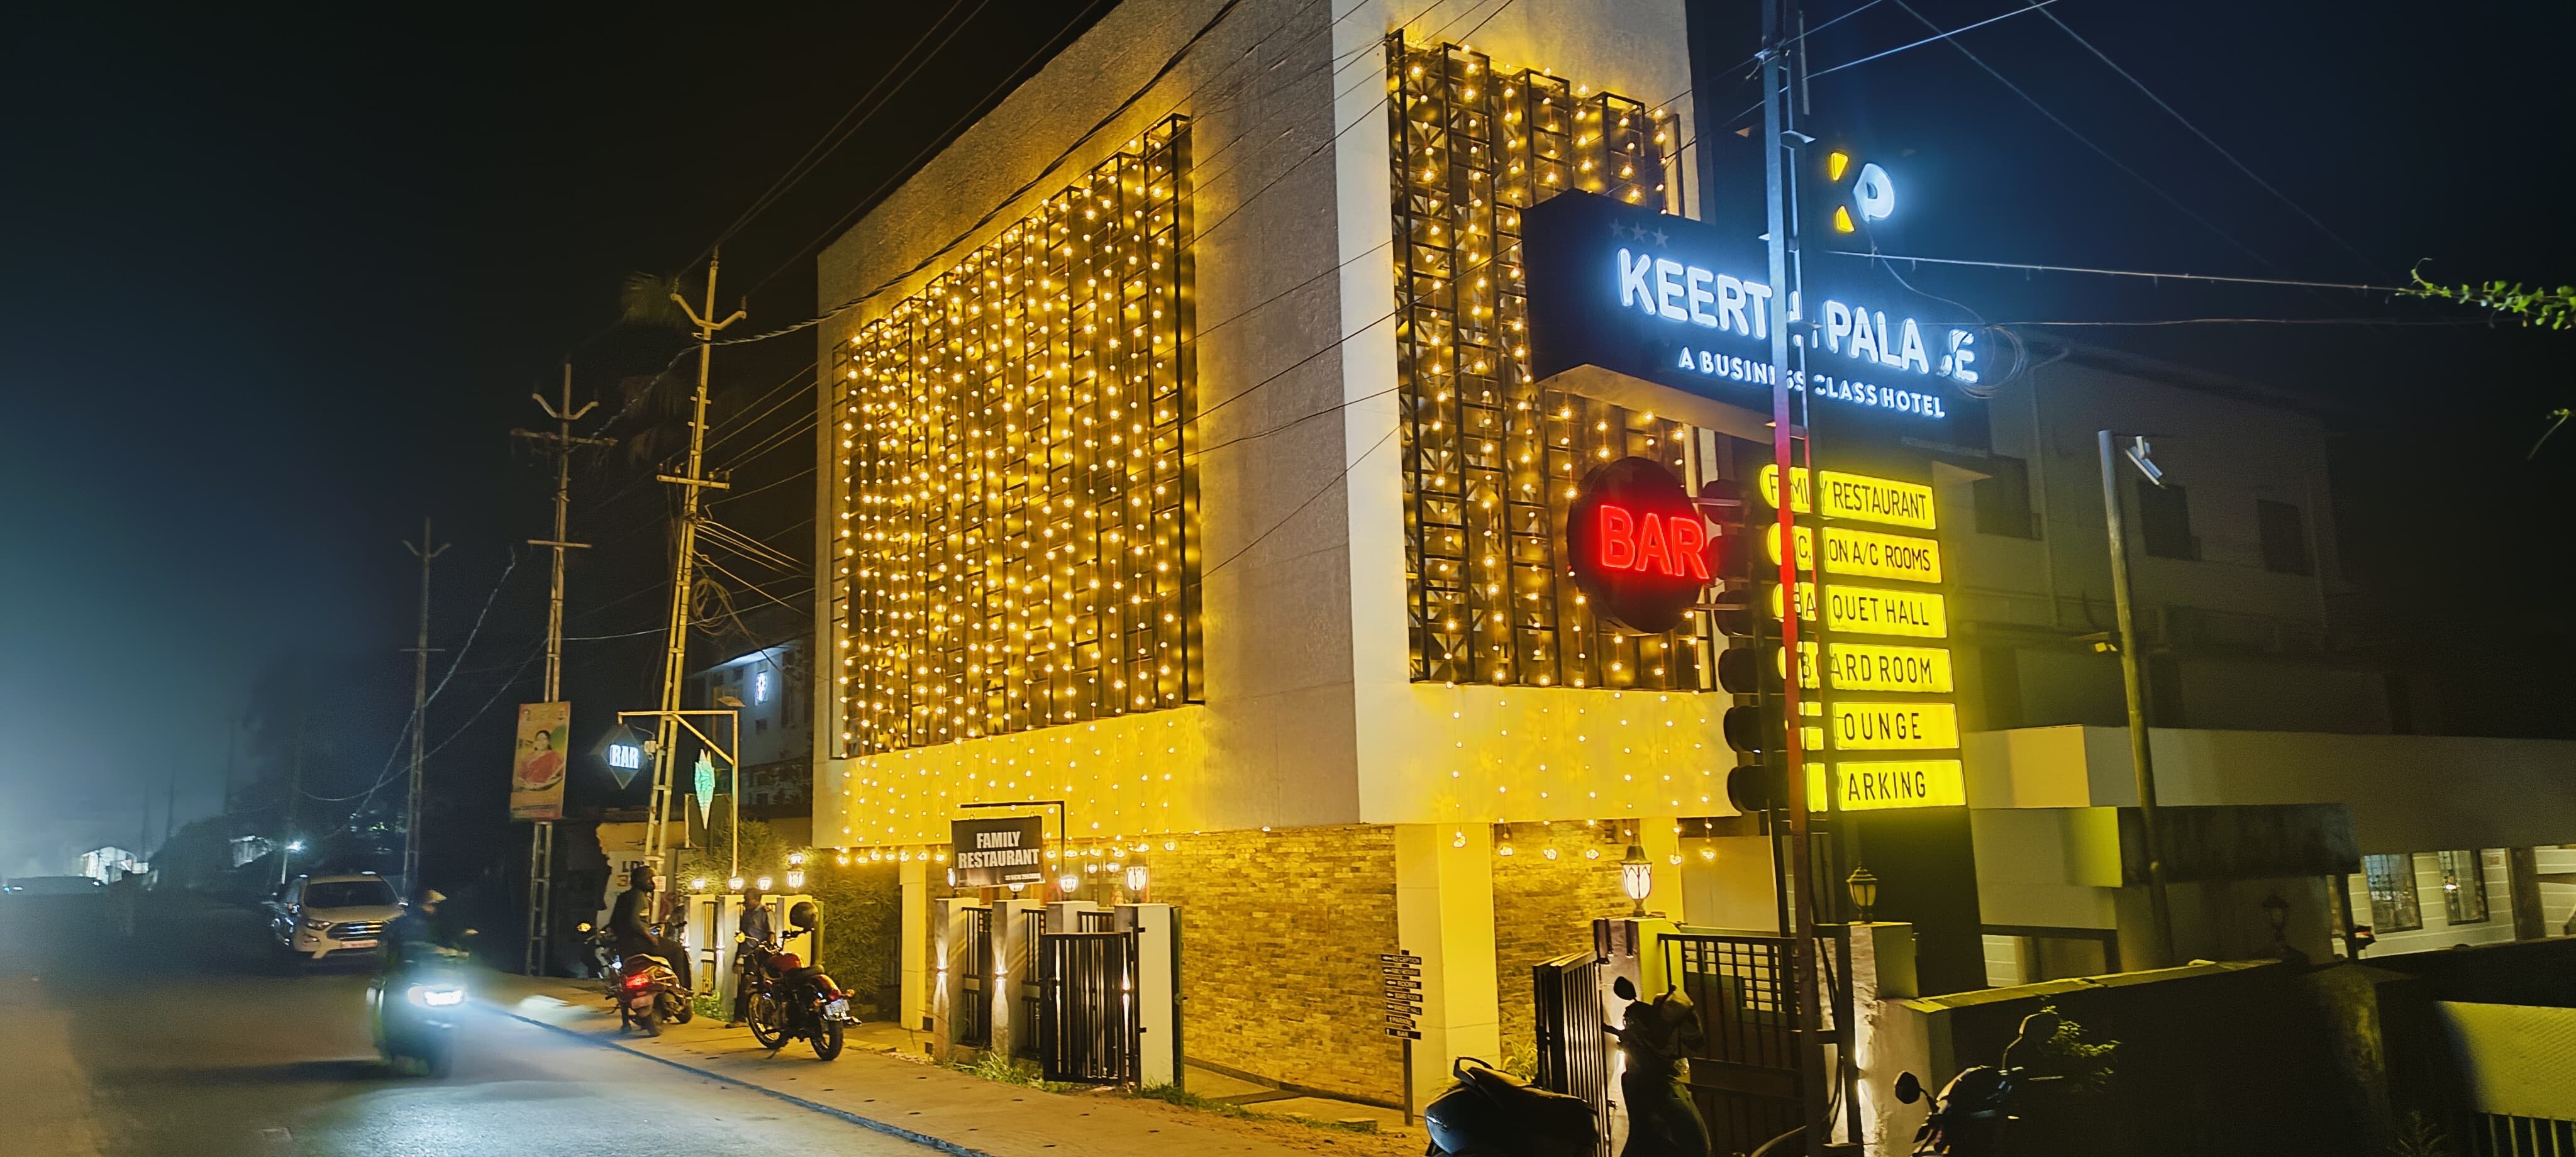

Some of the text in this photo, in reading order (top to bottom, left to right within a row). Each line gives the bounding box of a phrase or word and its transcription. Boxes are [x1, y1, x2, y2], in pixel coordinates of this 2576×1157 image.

[1823, 299, 1979, 384] PALAE
[1679, 346, 1696, 370] A
[1879, 387, 1945, 418] HOTEL
[1833, 480, 1926, 520] RESTAURANT
[1601, 504, 1710, 579] BAR
[1853, 541, 1879, 565] A/C
[1885, 544, 1931, 572] ROOMS
[1885, 599, 1929, 626] HALL
[1879, 655, 1933, 684] ROOM
[1843, 712, 1922, 741] OUNGE
[609, 744, 639, 769] BAR
[1848, 771, 1926, 801] ARKING
[976, 831, 1021, 849] FAMILY
[958, 848, 1040, 869] RESTAURANT
